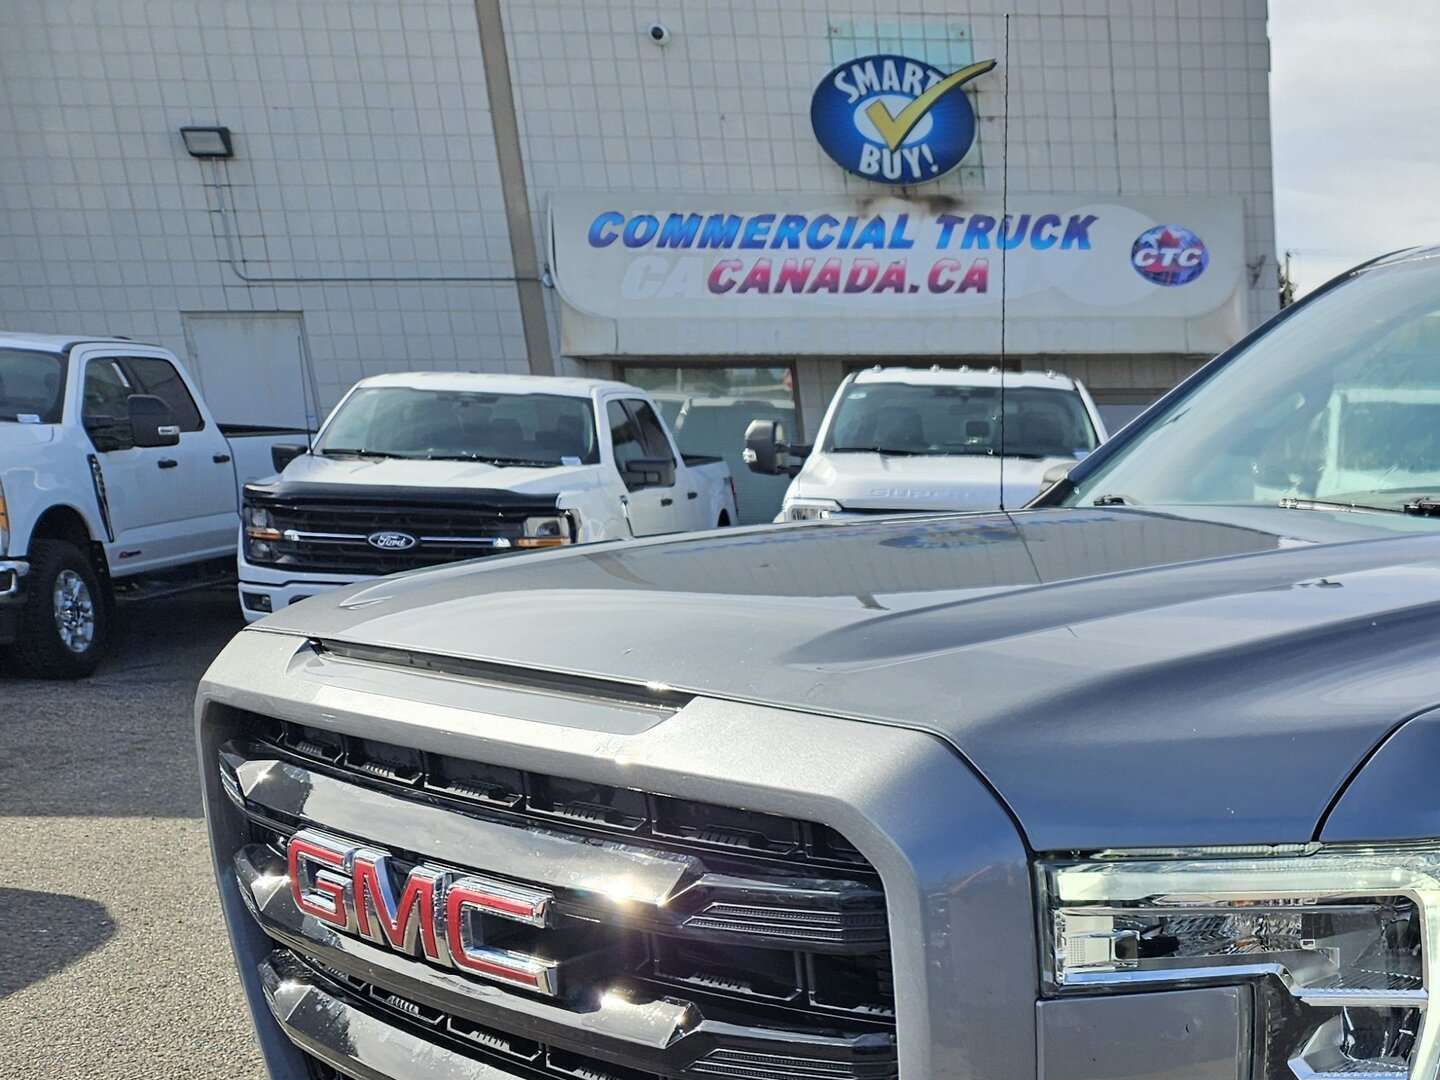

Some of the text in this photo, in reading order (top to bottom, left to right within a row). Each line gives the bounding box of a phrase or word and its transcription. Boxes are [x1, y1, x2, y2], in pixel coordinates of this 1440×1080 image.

[834, 60, 944, 104] SMART
[858, 143, 939, 180] BUY!
[587, 210, 1100, 250] COMMERCIAL TRUCK
[706, 256, 991, 295] CANADA.CA
[1133, 247, 1203, 268] CTC
[287, 828, 558, 998] GMC
